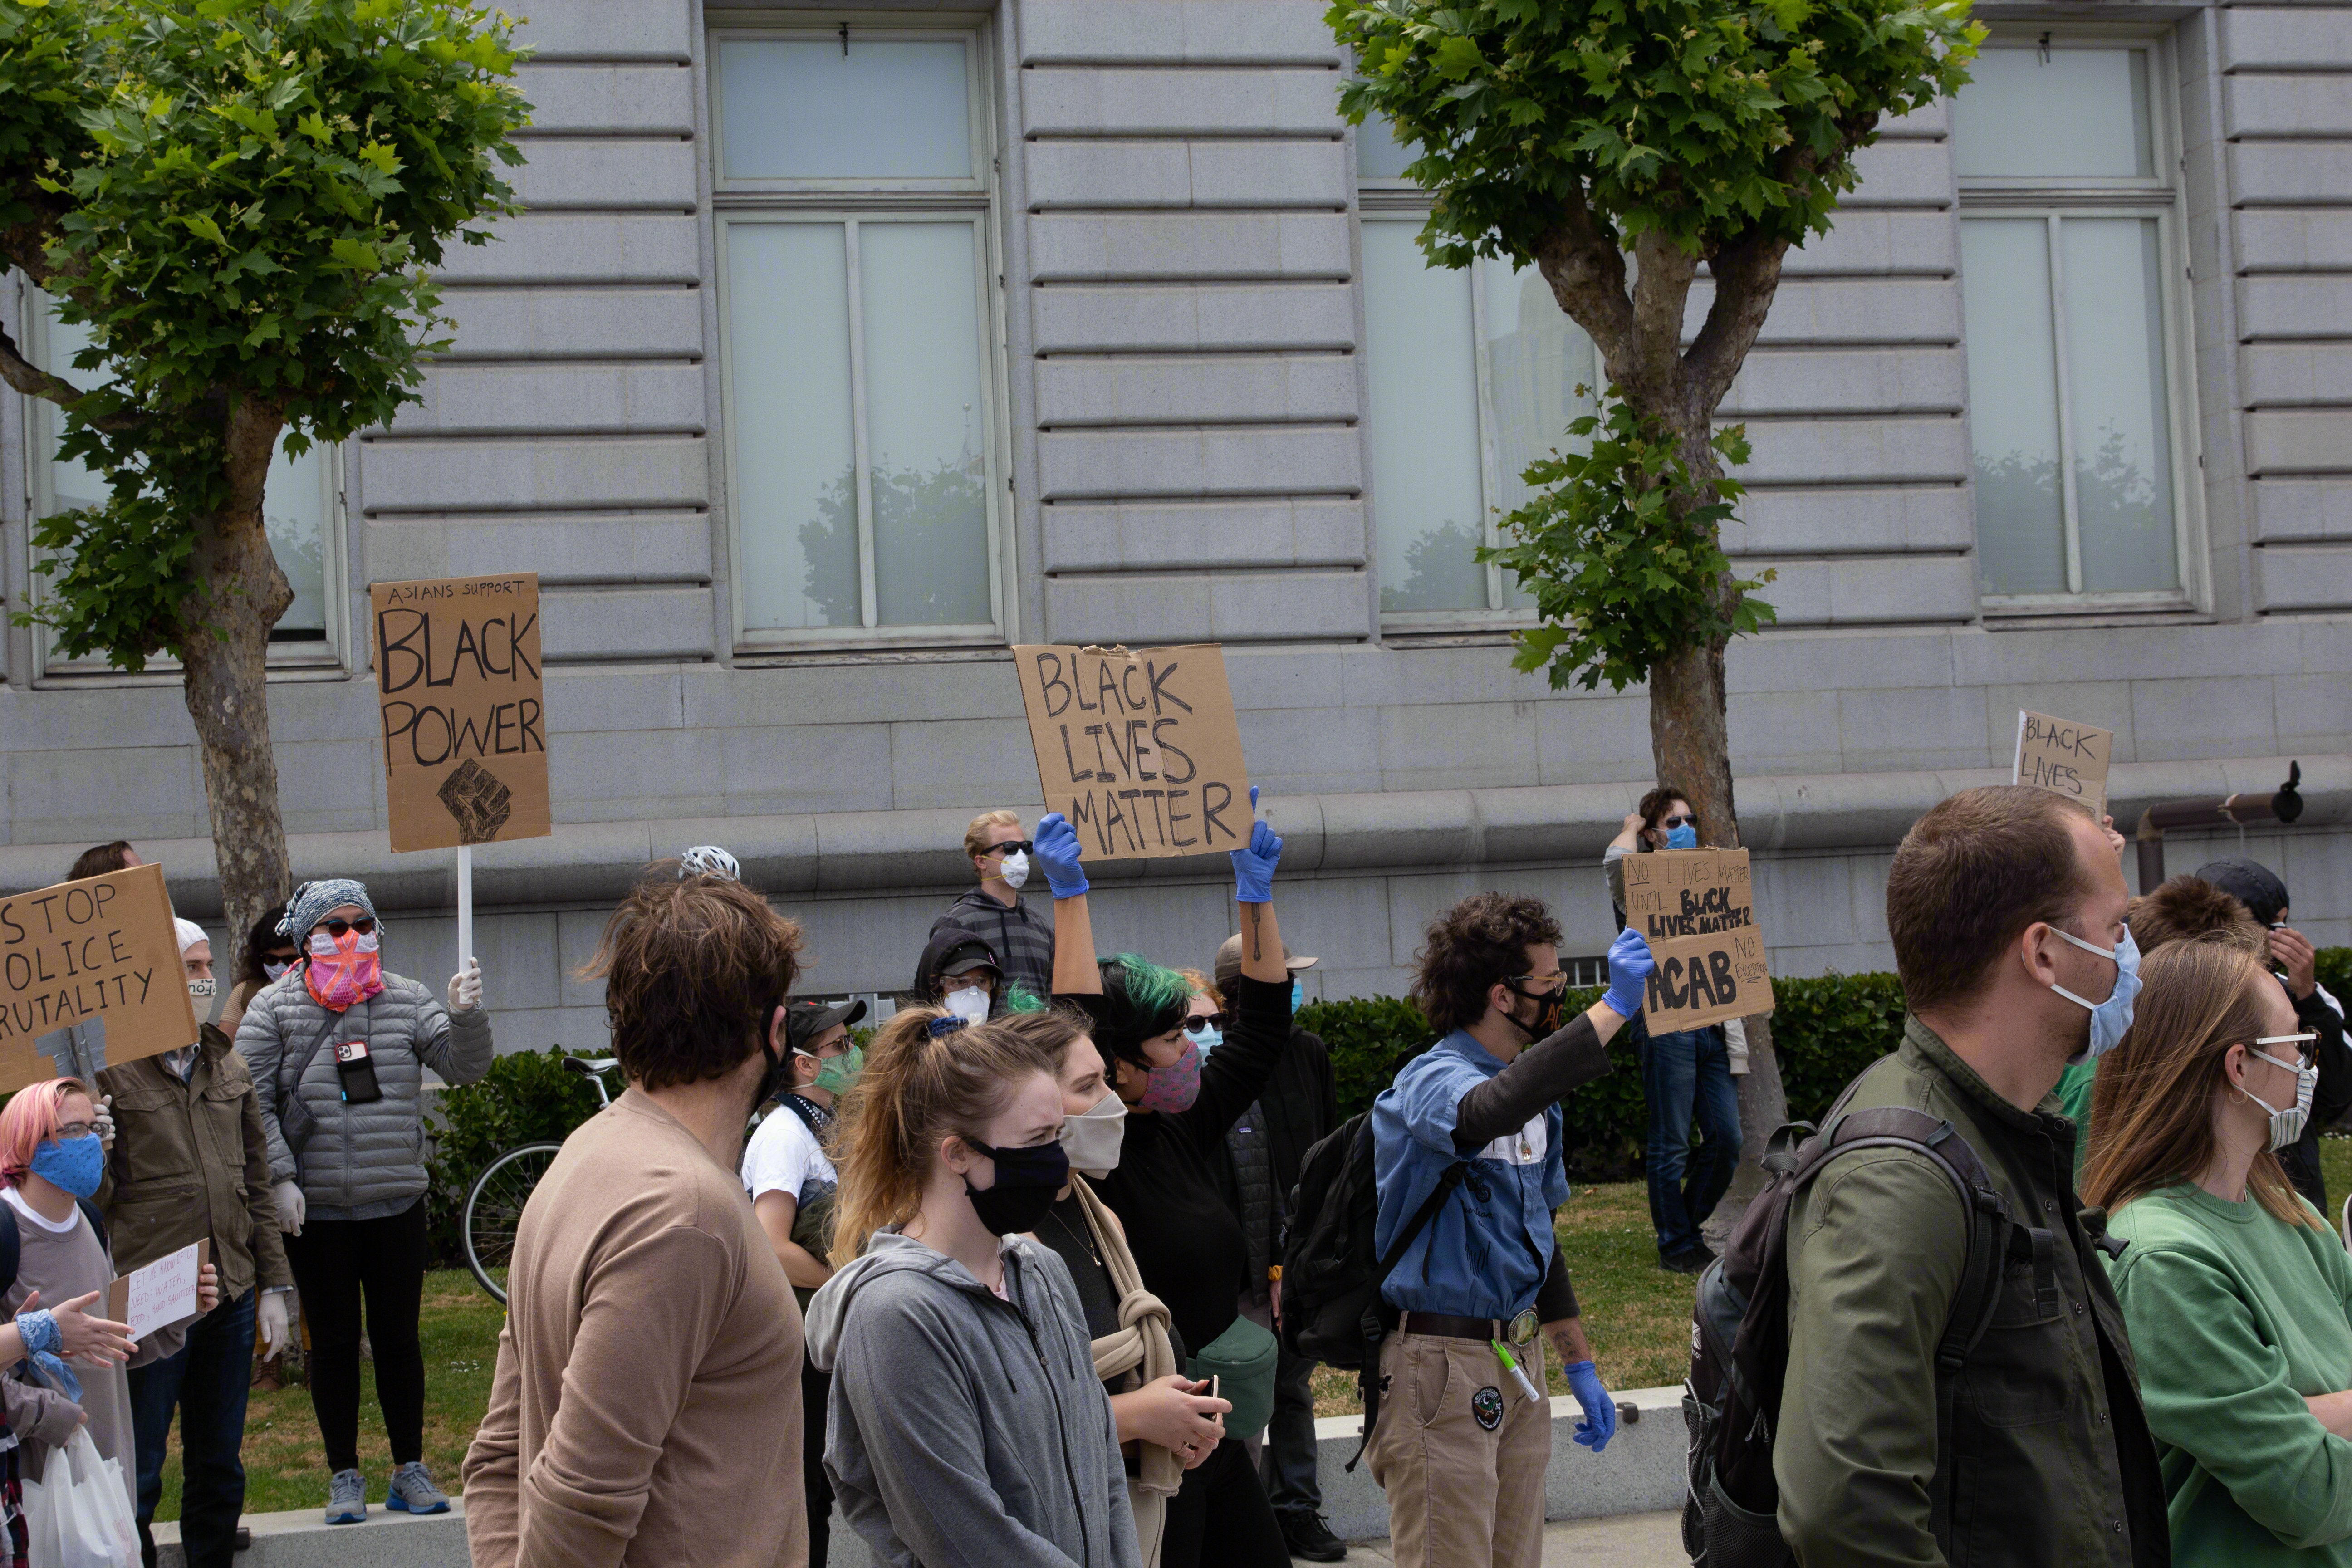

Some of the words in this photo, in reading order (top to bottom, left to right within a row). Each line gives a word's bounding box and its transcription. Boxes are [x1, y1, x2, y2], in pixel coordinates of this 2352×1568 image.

[388, 584, 454, 604] ASIANS
[462, 580, 524, 598] SUPPORT
[379, 608, 539, 695] BLACK
[1037, 652, 1193, 719] BLACK
[382, 698, 545, 776] POWER
[1060, 718, 1196, 784] LIVES
[2026, 717, 2099, 760] BLACK
[2021, 752, 2082, 794] LIVES
[1073, 782, 1236, 855] MATTER
[1627, 858, 1649, 882] NO
[1667, 858, 1710, 885] LIVES
[1717, 862, 1750, 884] MATTER
[0, 884, 116, 945] STOP
[1632, 890, 1669, 912] UNTIL
[1680, 887, 1732, 917] BLACK
[1647, 913, 1697, 941] LIVES
[1699, 906, 1752, 936] MATTER
[5, 930, 132, 991] OLICE
[1735, 936, 1755, 960] NO
[0, 968, 152, 1040] RUTALITY
[1646, 950, 1737, 1013] ACAB
[131, 1271, 146, 1293] LET
[150, 1265, 157, 1282] ME
[160, 1259, 176, 1274] KNOW
[176, 1252, 183, 1265] IF
[187, 1248, 193, 1259] U
[152, 1300, 166, 1314] HAND
[168, 1284, 196, 1305] SANITIZER
